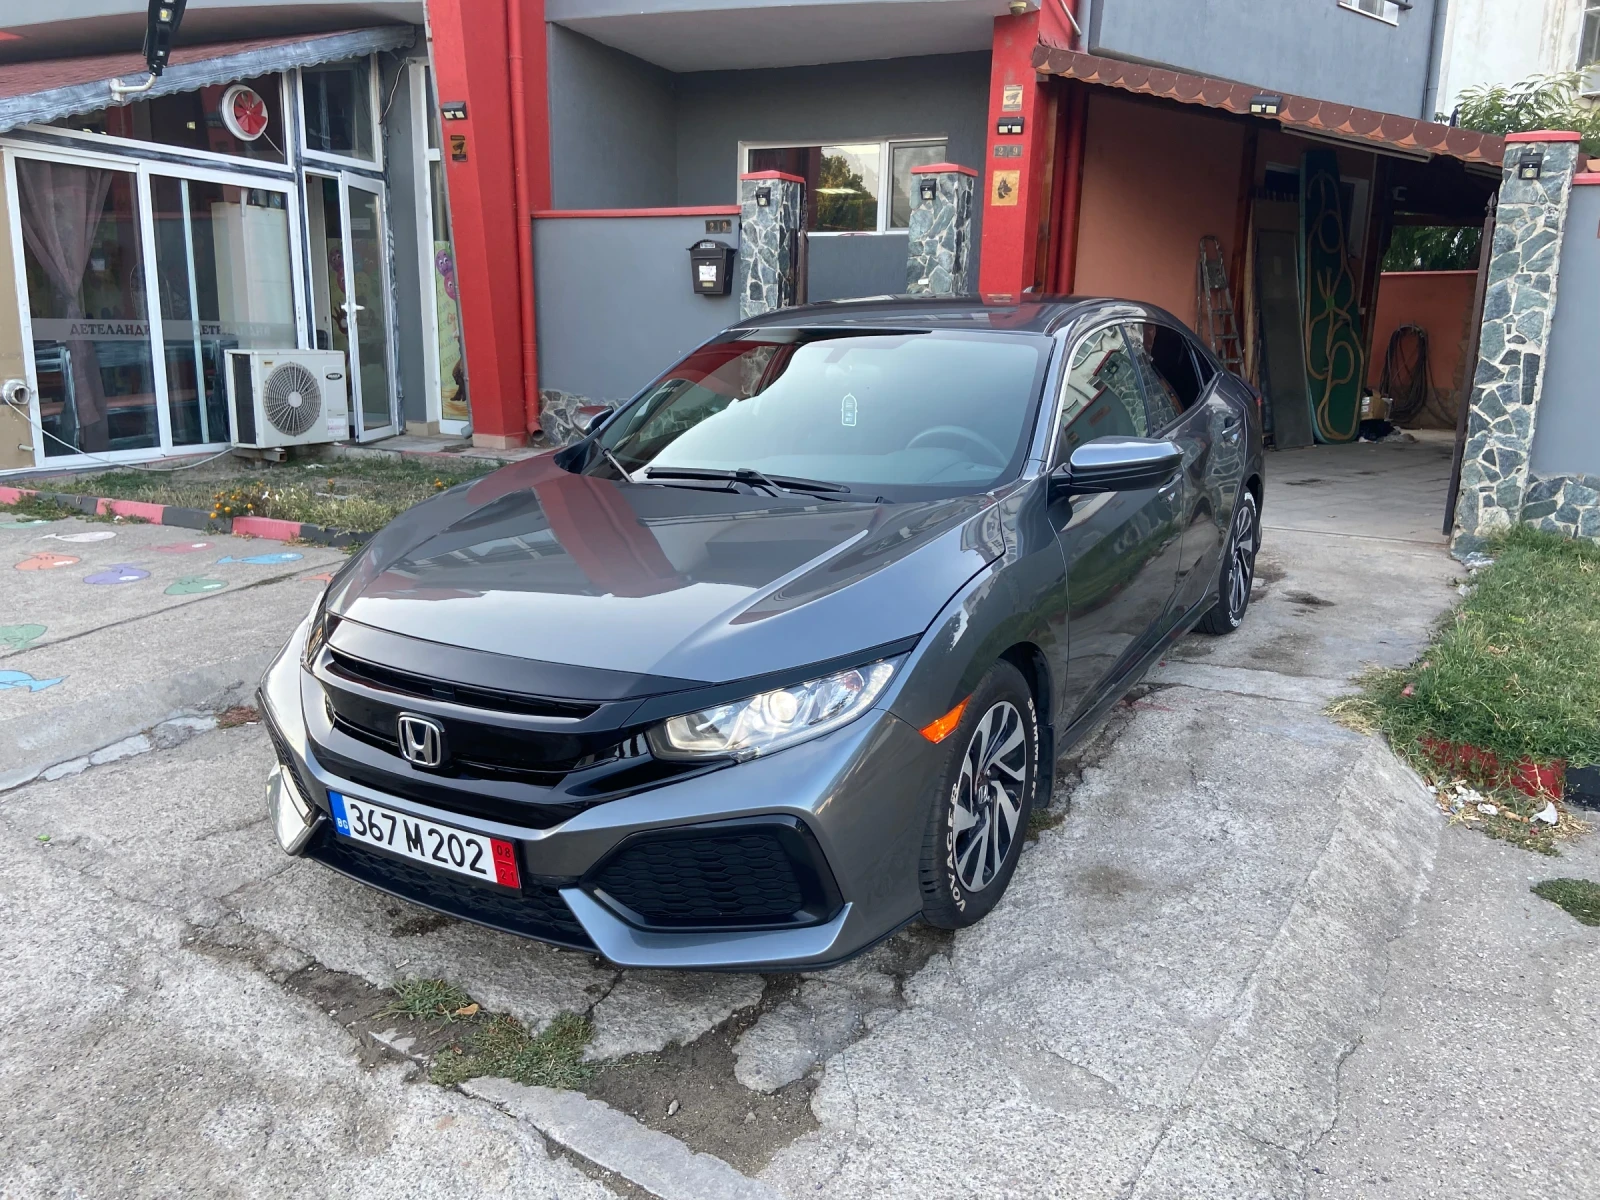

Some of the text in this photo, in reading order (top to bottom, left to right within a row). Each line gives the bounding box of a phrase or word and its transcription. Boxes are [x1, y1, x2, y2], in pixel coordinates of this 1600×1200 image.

[1027, 697, 1039, 799] SUMMER
[337, 817, 349, 830] BG
[497, 844, 511, 858] 08
[946, 782, 967, 912] VOYAGER
[500, 869, 515, 882] 21
